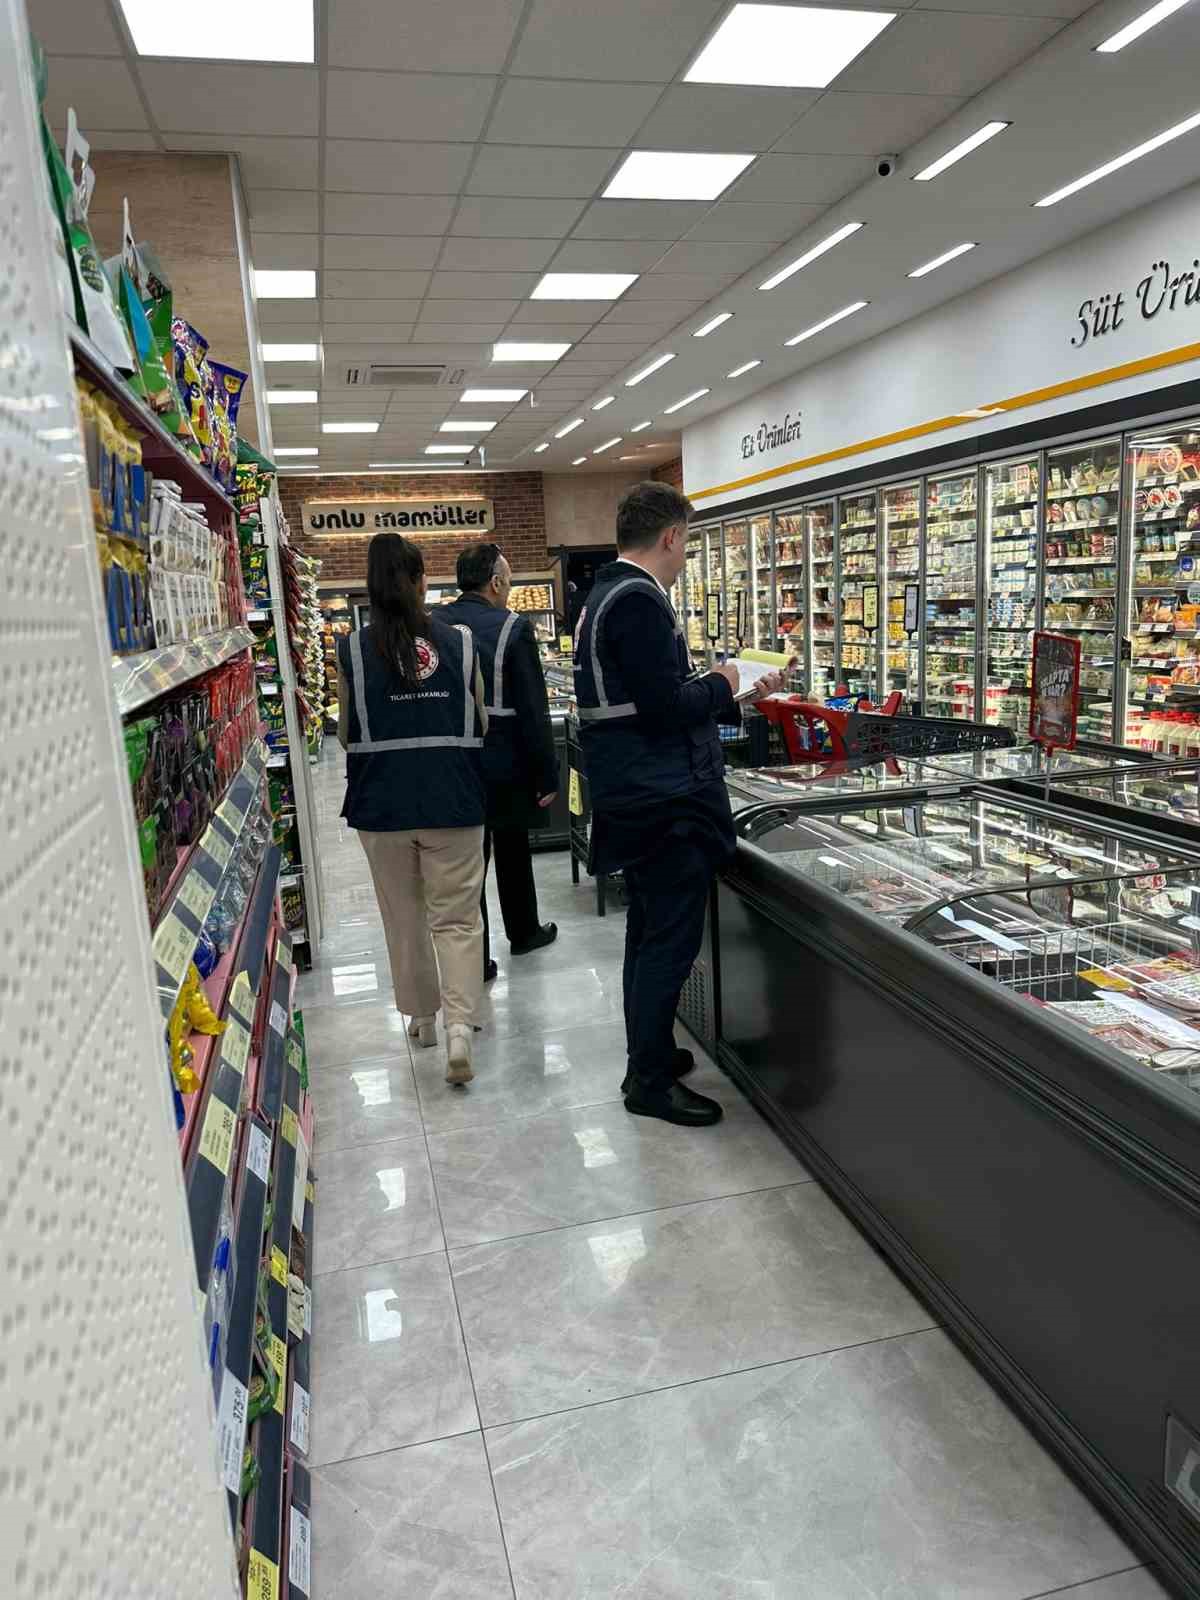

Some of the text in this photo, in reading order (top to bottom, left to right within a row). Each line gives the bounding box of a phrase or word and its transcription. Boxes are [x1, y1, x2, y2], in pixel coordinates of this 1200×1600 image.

[1071, 292, 1124, 348] Süt
[741, 434, 755, 459] Et
[310, 504, 488, 529] unlu mamüller
